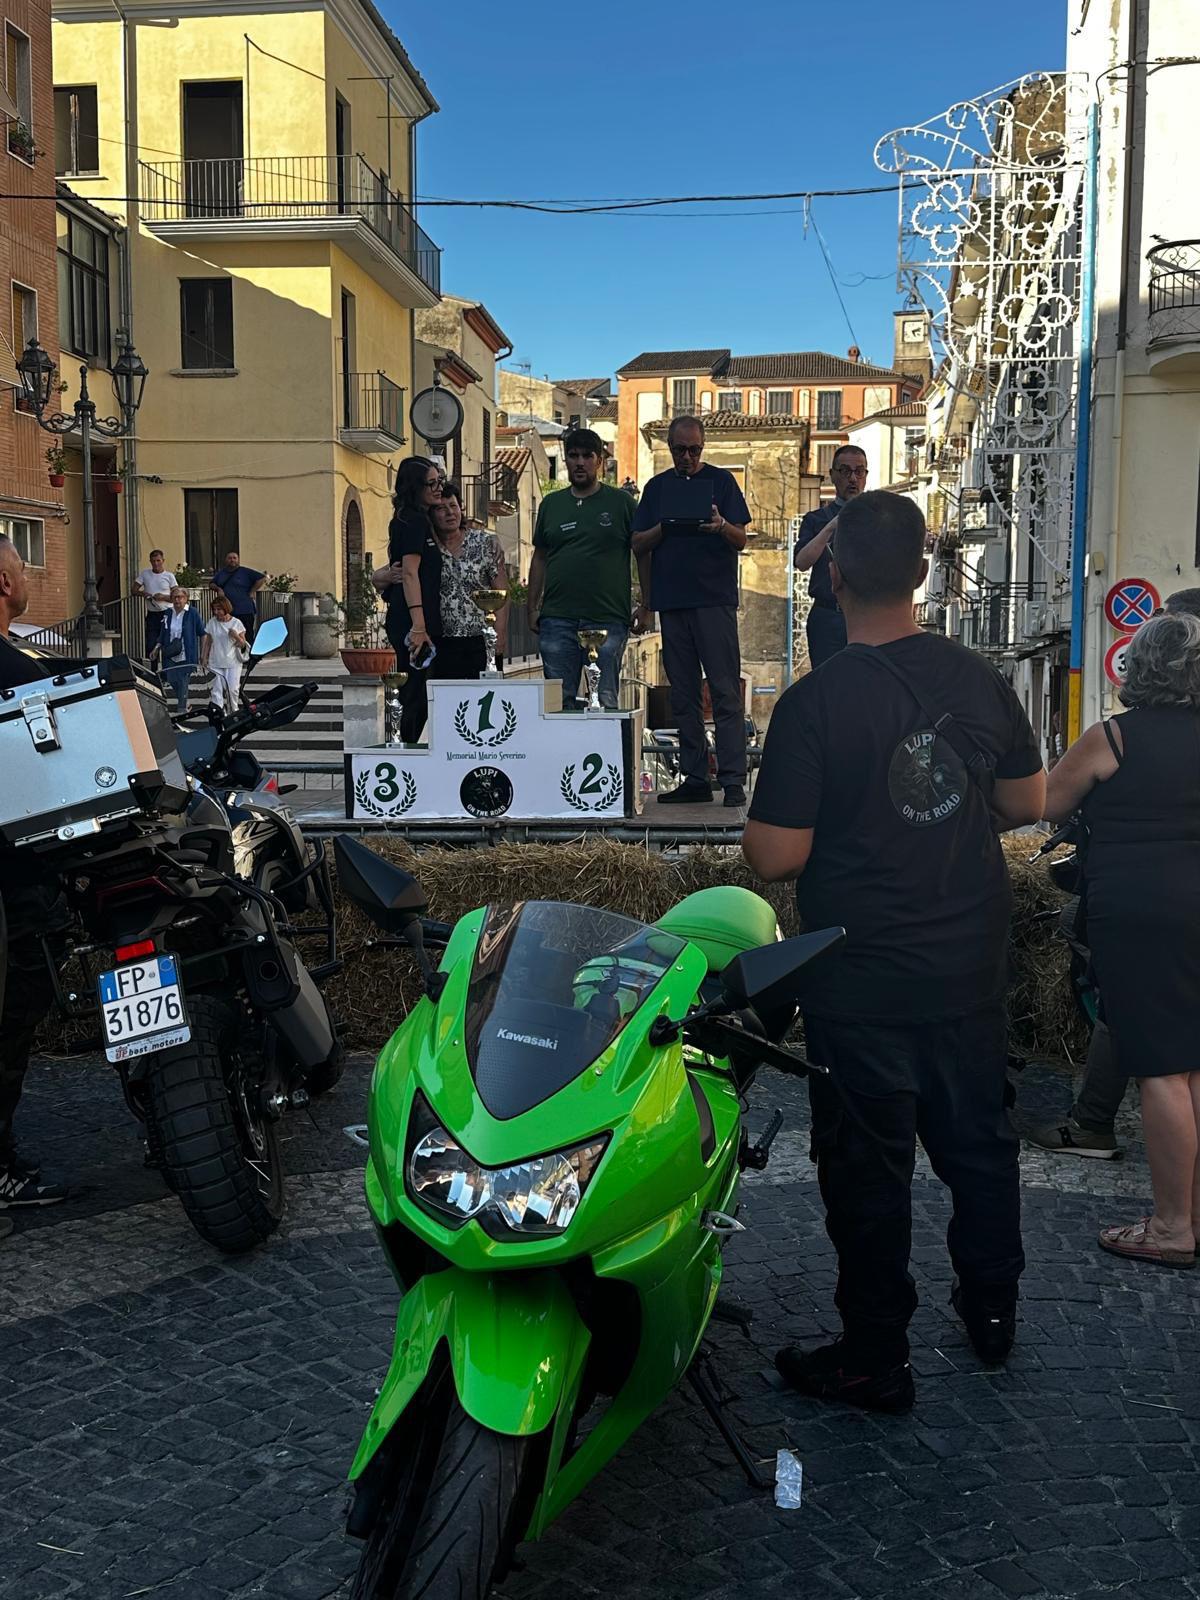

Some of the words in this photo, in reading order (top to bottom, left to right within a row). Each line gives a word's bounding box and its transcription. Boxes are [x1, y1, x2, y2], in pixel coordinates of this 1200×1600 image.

[476, 690, 495, 734] 1
[446, 751, 477, 761] Memorial
[478, 751, 498, 761] Mario
[499, 751, 527, 761] Severino
[373, 762, 400, 802] 3
[473, 768, 498, 778] LUPI
[578, 752, 609, 795] 2
[466, 803, 476, 813] ON
[476, 809, 489, 817] THE
[490, 804, 507, 816] ROAD
[902, 804, 916, 819] ON
[915, 811, 932, 822] THE
[932, 793, 961, 818] ROAD
[117, 967, 145, 997] FP
[106, 992, 181, 1036] 31876
[151, 1036, 184, 1050] motors
[496, 1028, 559, 1050] Kawasaki
